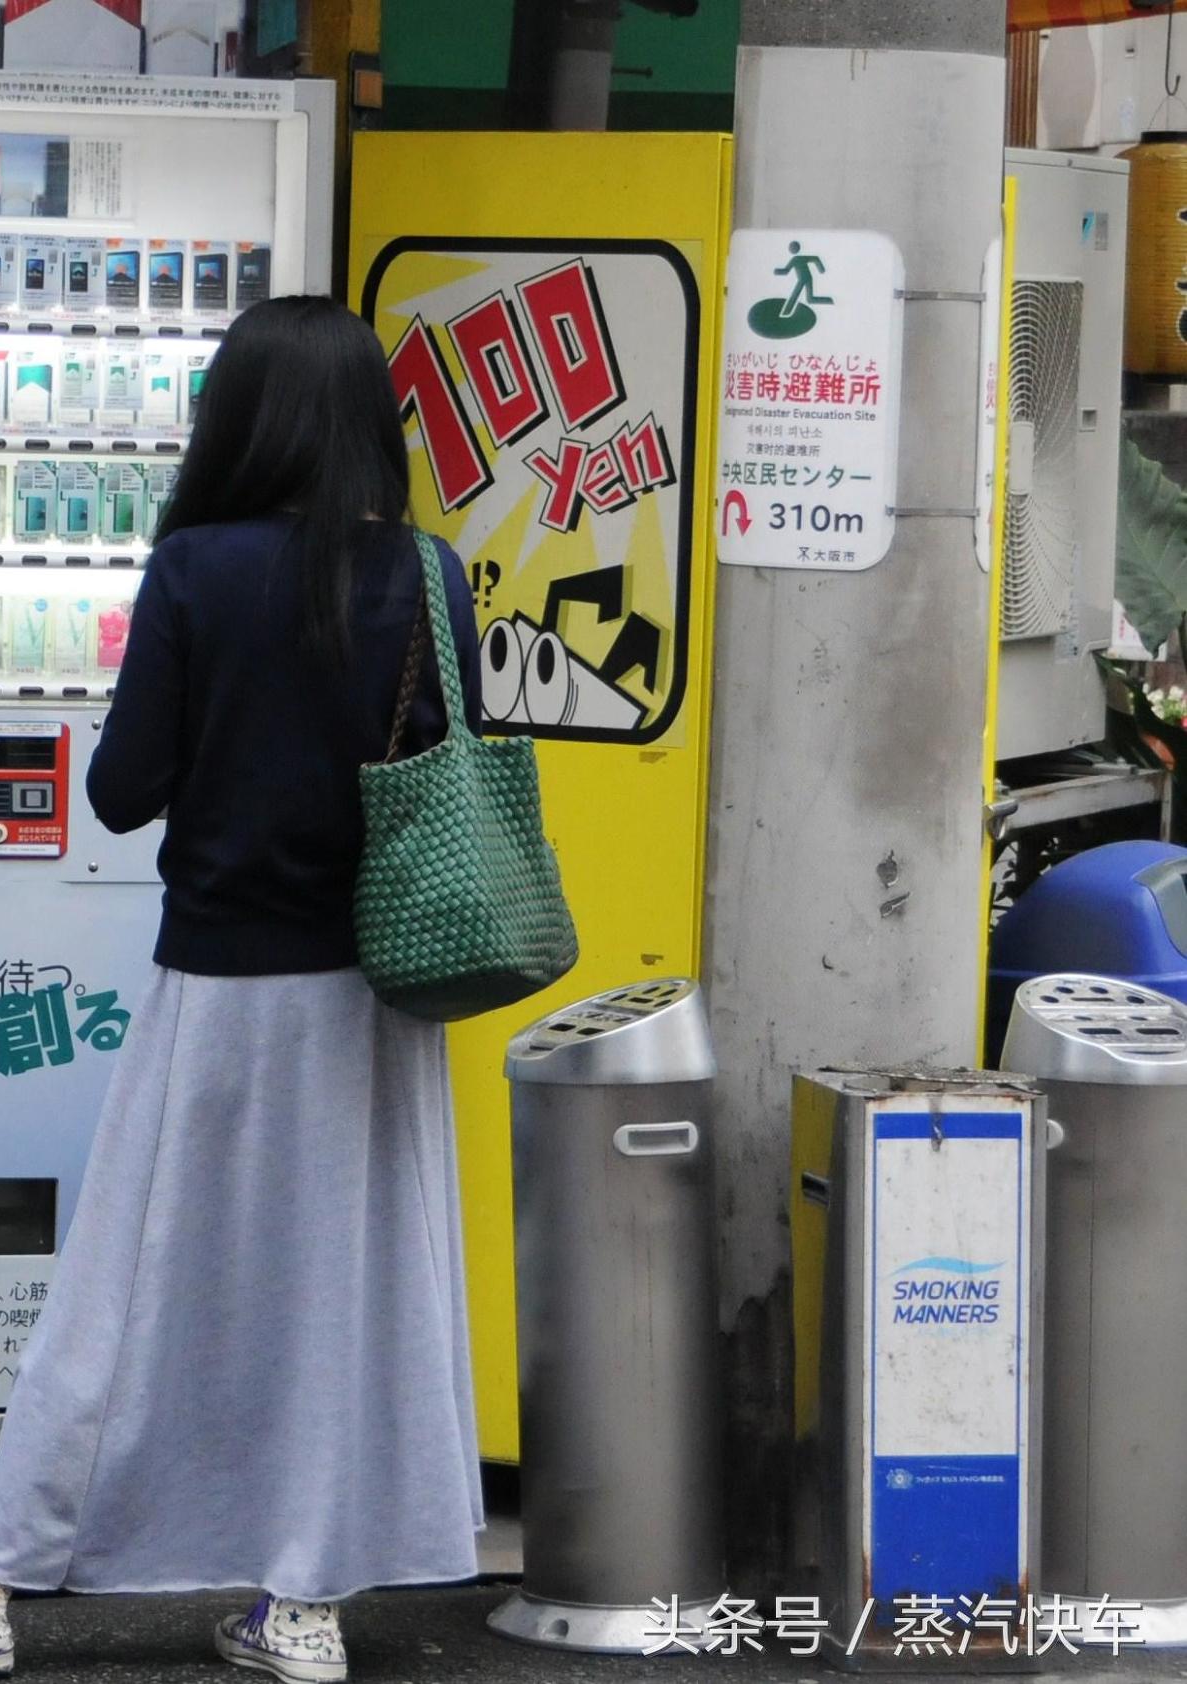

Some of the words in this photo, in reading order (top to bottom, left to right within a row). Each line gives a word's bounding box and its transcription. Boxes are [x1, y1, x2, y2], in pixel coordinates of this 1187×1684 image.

[789, 354, 878, 374] ひなんじょ
[387, 257, 627, 514] 100
[755, 407, 791, 418] Disaster
[793, 408, 852, 420] Evacuation
[854, 410, 877, 421] Site
[523, 412, 677, 534] yen
[769, 503, 864, 533] 310m
[813, 549, 856, 563] 大阪市
[893, 1280, 1000, 1300] SMOKING
[893, 1303, 999, 1324] MANNERS
